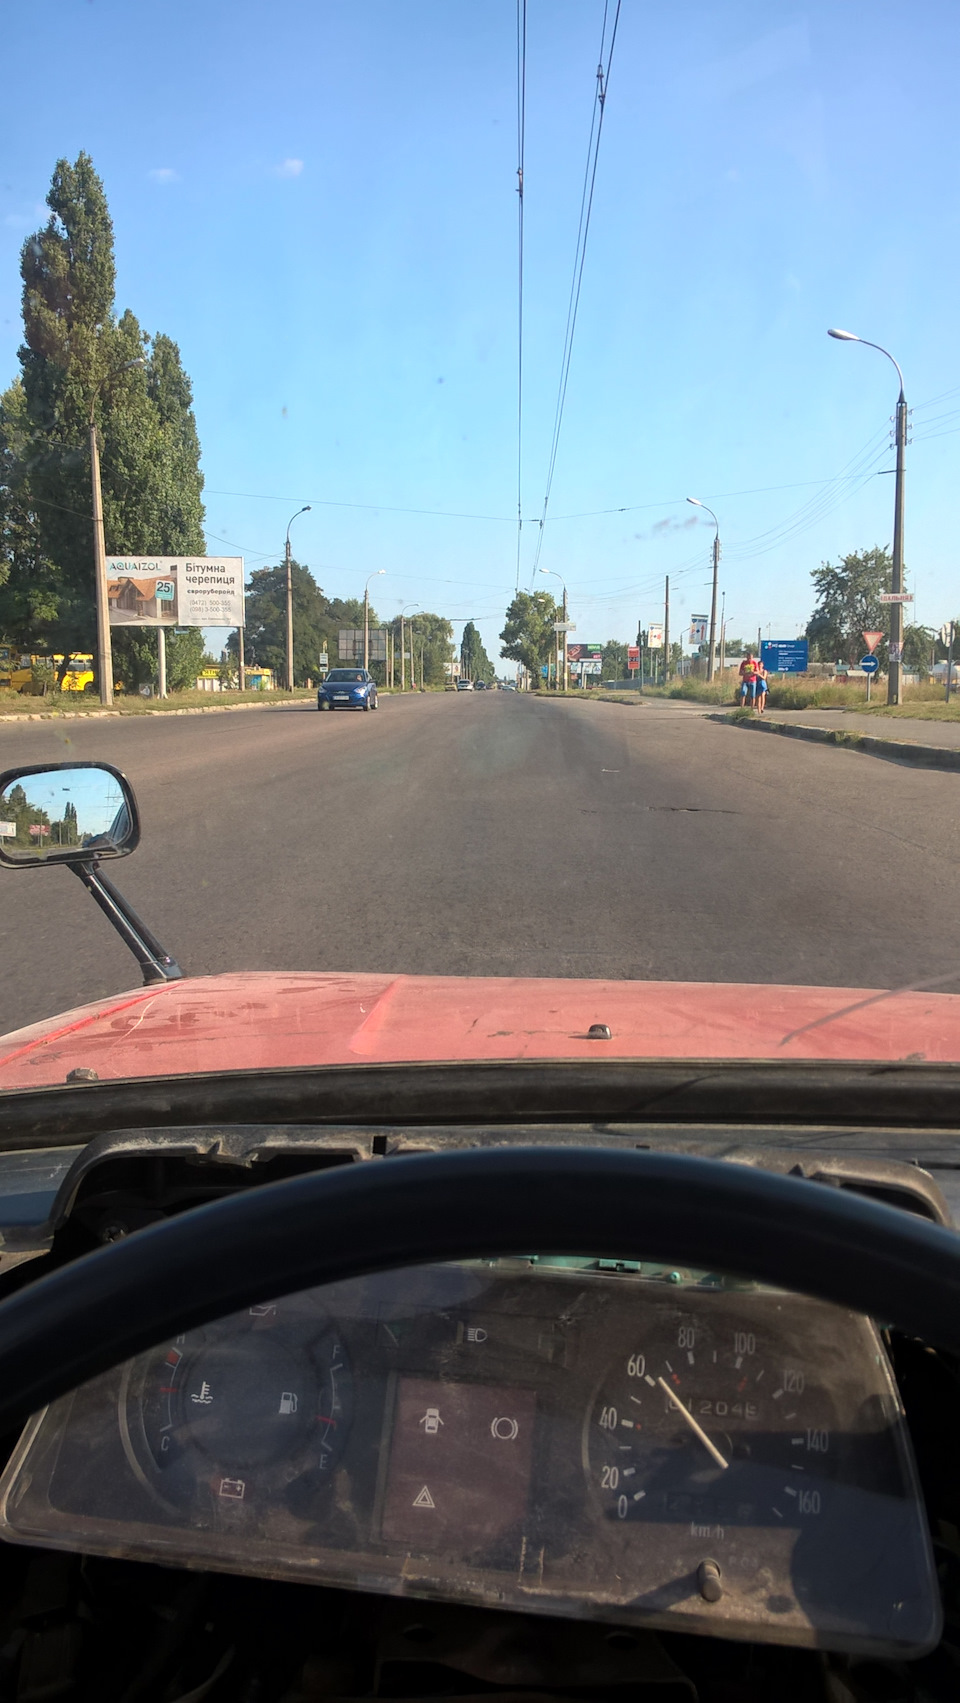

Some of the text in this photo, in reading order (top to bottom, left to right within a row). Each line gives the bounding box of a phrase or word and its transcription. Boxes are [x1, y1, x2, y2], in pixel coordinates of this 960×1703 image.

[110, 562, 161, 571] AQUAIZOL
[185, 562, 226, 574] Бітумна
[157, 581, 171, 593] 25
[185, 576, 235, 586] черепиця
[677, 1327, 695, 1349] 80
[734, 1332, 756, 1355] 100
[332, 1344, 341, 1360] F
[627, 1354, 646, 1377] 60
[782, 1370, 804, 1393] 120
[600, 1407, 618, 1430] 40
[160, 1435, 170, 1451] C
[806, 1428, 829, 1451] 140
[319, 1453, 328, 1469] E
[601, 1466, 619, 1489] 20
[617, 1494, 628, 1519] 0
[798, 1491, 821, 1514] 160
